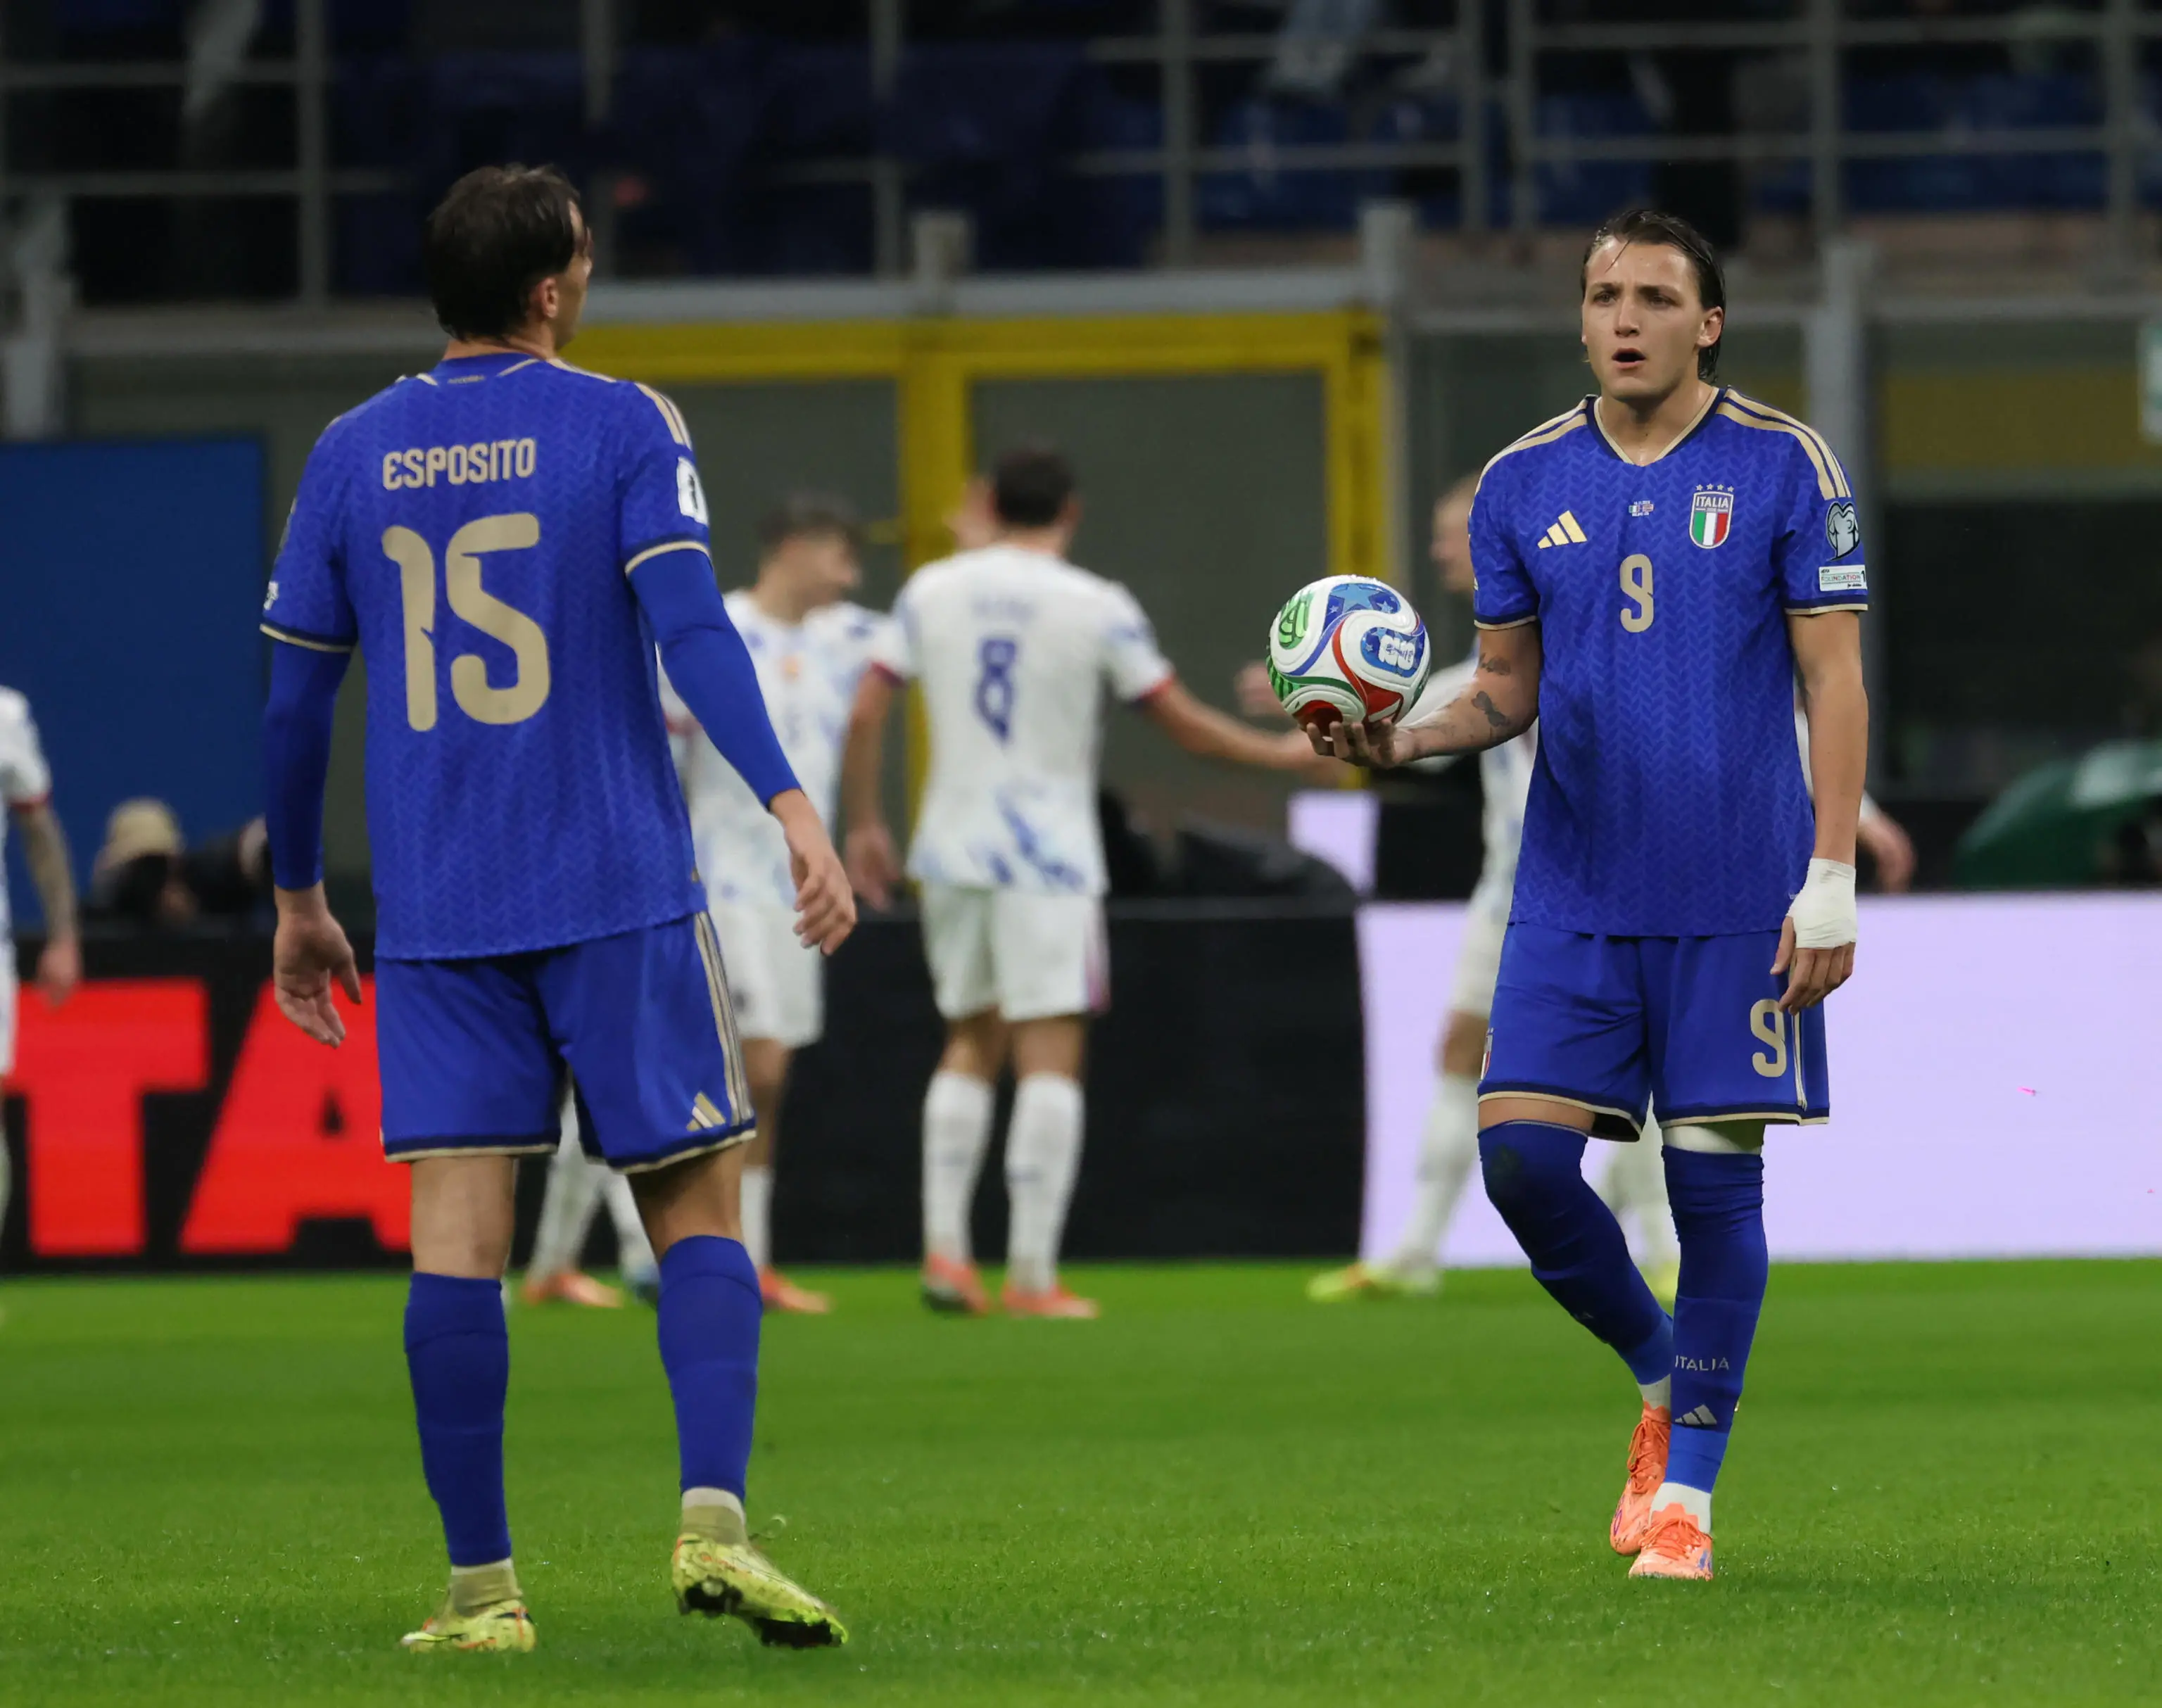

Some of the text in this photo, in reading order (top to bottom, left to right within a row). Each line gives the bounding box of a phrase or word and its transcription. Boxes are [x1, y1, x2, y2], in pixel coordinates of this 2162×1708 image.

[383, 438, 536, 491] ESPOSITO
[1696, 495, 1729, 508] ITALIA
[381, 512, 551, 732] 15
[1619, 553, 1654, 633] 9
[975, 638, 1017, 745] 8
[1750, 999, 1787, 1077] 9
[1674, 1355, 1730, 1371] ITALIA
